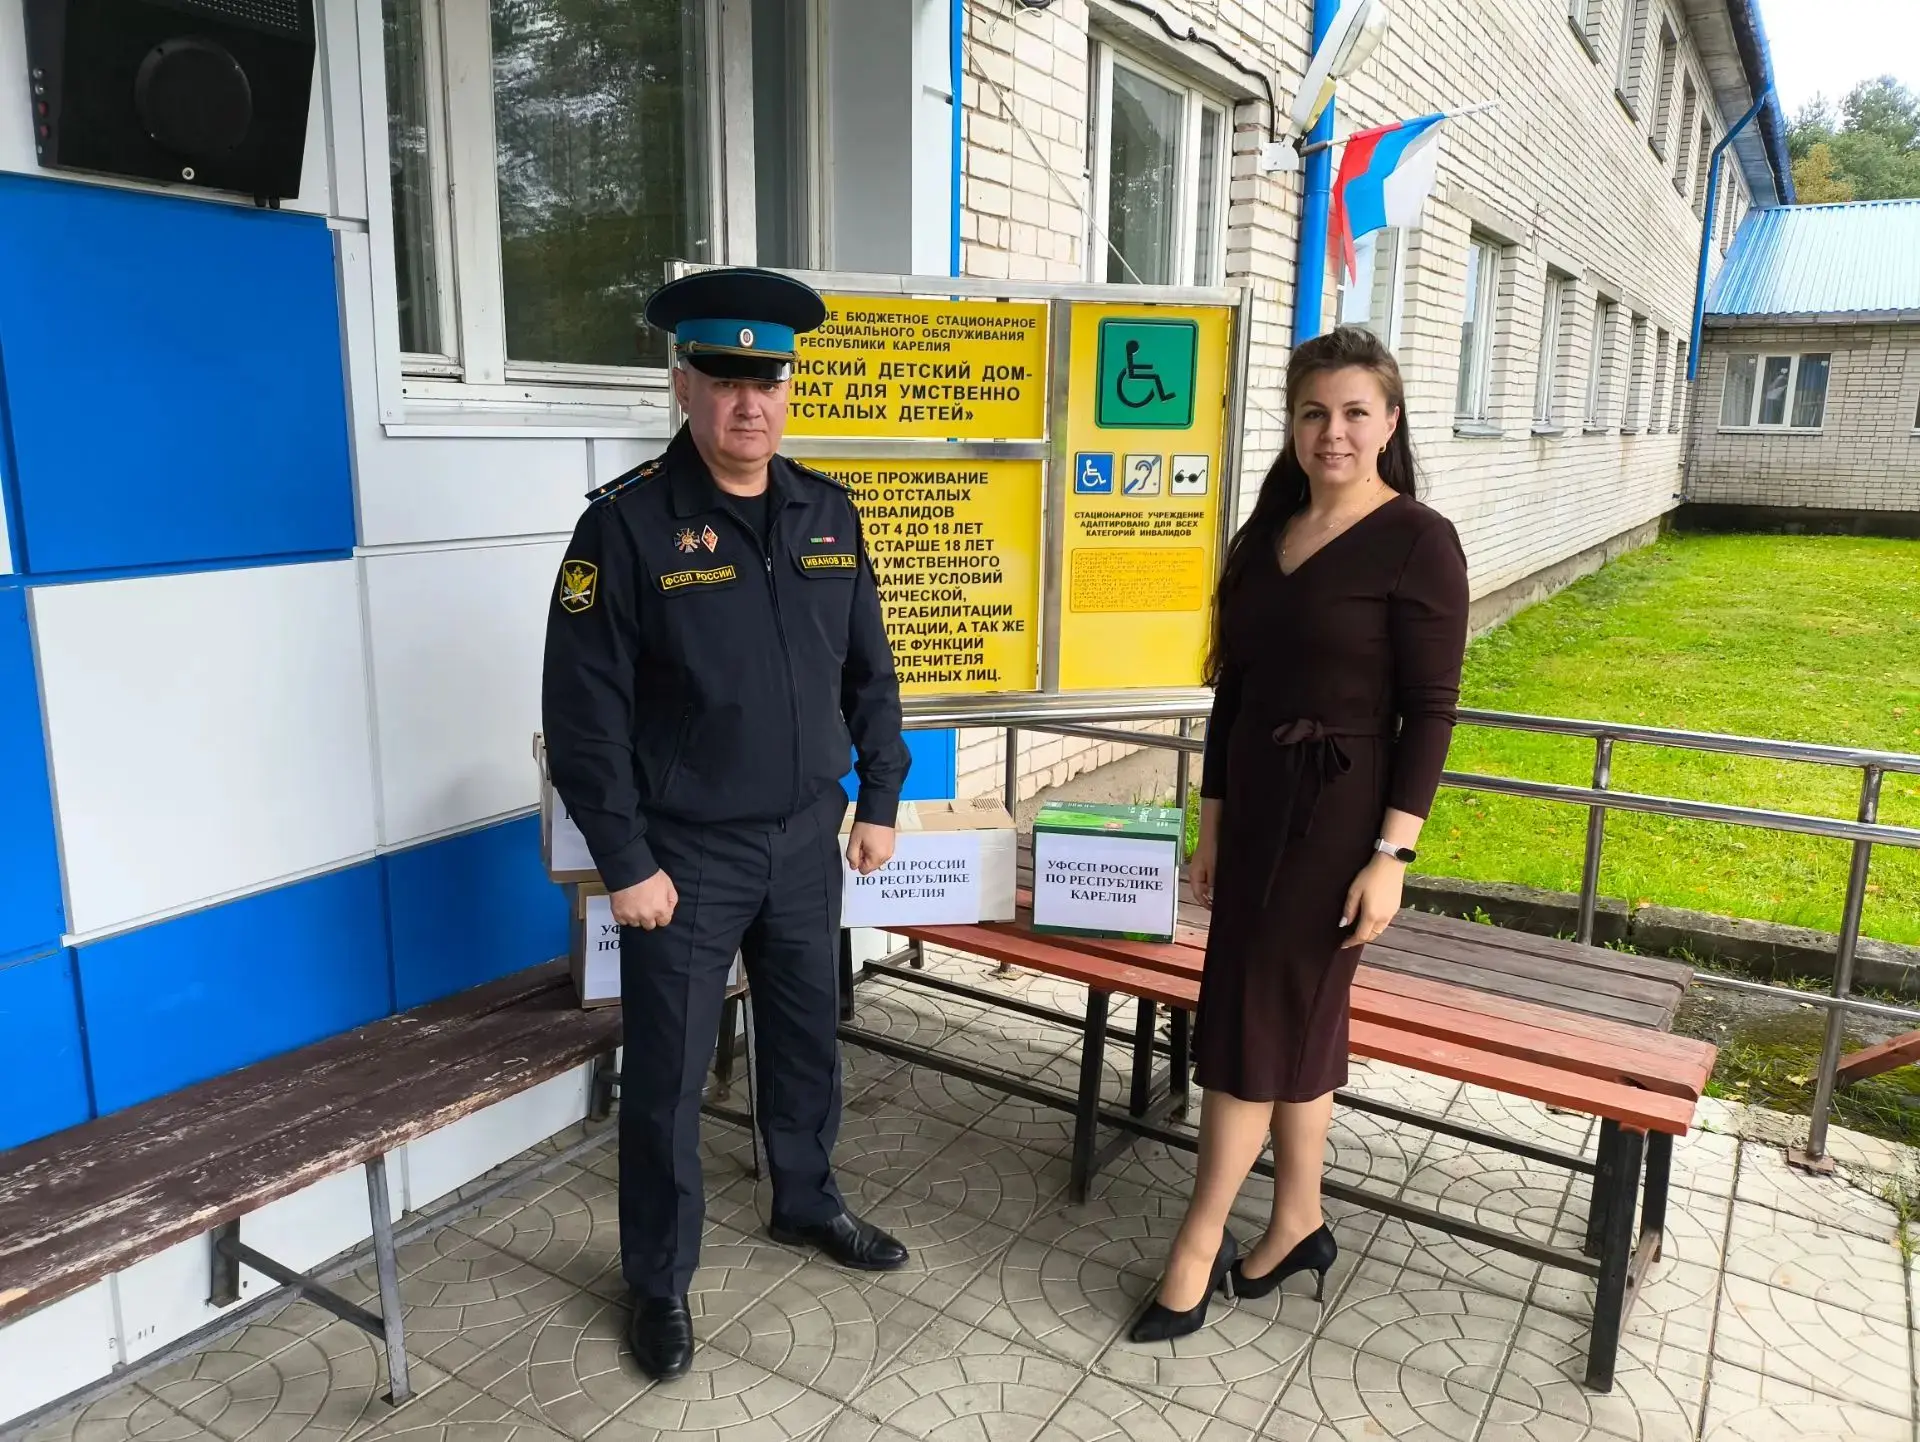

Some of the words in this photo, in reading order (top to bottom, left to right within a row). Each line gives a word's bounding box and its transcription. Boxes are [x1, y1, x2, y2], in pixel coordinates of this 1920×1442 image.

[846, 312, 928, 324] БЮДЖЕТНОЕ
[937, 315, 1036, 328] СТАЦИОНАРНОЕ
[817, 325, 915, 337] СОЦИАЛЬНОГО
[922, 328, 1025, 341] ОБСЛУЖИВАНИЯ
[800, 337, 885, 349] РЕСПУБЛИКИ
[893, 340, 951, 352] КАРЕЛИЯ
[879, 361, 971, 380] ДЕТСКИЙ
[982, 365, 1033, 382] ДОМ-
[845, 383, 887, 400] ДЛЯ
[900, 384, 1020, 401] УМСТВЕННО
[786, 403, 887, 419] ТСТАЛЫХ
[899, 402, 974, 422] ДЕТЕЙ»
[877, 471, 989, 484] ПРОЖИВАНИЕ
[883, 488, 971, 501] ОТСТАЛЫХ
[1074, 511, 1144, 519] СТАЦИОНАРНОЕ
[1148, 511, 1205, 520] УЧРЕЖДЕНИЕ
[869, 523, 891, 536] ОТ
[894, 523, 902, 535] 4
[906, 522, 929, 537] ДО
[933, 523, 949, 535] 18
[953, 523, 984, 535] ЛЕТ
[1080, 520, 1150, 529] АДАПТИРОВАНО
[1154, 520, 1172, 529] ДЛЯ
[1176, 520, 1198, 528] ВСЕХ
[1086, 527, 1136, 537] КАТЕГОРИЙ
[1139, 529, 1192, 538] ИНВАЛИДОВ
[874, 540, 941, 552] СТАРШЕ
[944, 540, 961, 551] 18
[965, 539, 995, 551] ЛЕТ
[806, 556, 839, 567] ИВАНОВ
[884, 556, 1000, 568] УМСТВЕННОГО
[665, 573, 693, 586] ФССП
[695, 568, 733, 581] РОССИИ
[929, 570, 1003, 586] УСЛОВИЙ
[887, 605, 1013, 618] РЕАБИЛИТАЦИИ
[957, 622, 967, 633] А
[971, 621, 999, 633] ТАК
[1002, 620, 1025, 632] ЖЕ
[910, 635, 984, 651] ФУНКЦИЙ
[966, 668, 1001, 684] ЛИЦ.
[910, 859, 966, 871] РОССИИ
[1047, 860, 1097, 873] УФССП
[1100, 864, 1159, 877] РОССИИ
[856, 876, 876, 886] ПО
[879, 873, 970, 885] РЕСПУБЛИКЕ
[1045, 873, 1066, 884] ПО
[1069, 876, 1164, 891] РЕСПУБЛИКЕ
[881, 888, 945, 898] КАРЕЛИЯ
[1071, 889, 1137, 903] КАРЕЛИЯ
